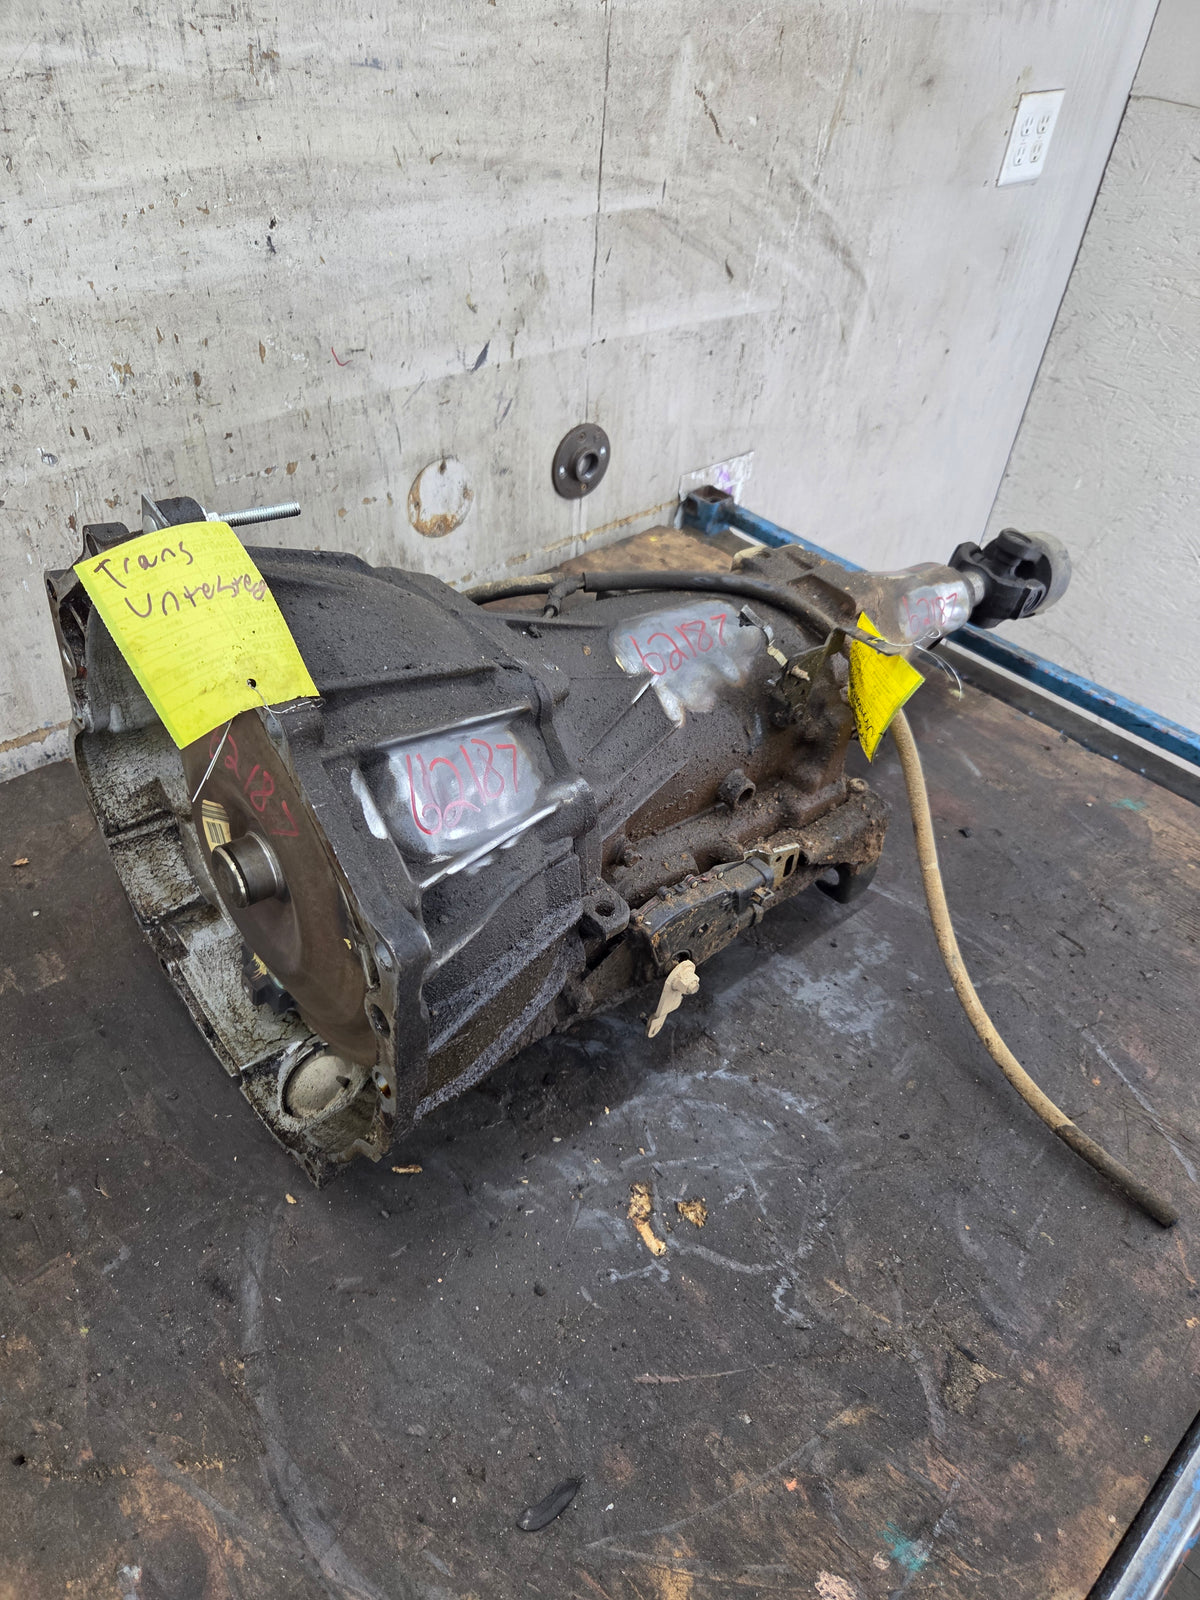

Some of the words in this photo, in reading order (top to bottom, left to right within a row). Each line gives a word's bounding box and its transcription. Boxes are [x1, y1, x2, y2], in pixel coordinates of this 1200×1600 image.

[94, 541, 193, 589] Trans
[902, 592, 959, 636] 62187
[629, 613, 728, 676] 62187
[406, 738, 520, 836] 62187
